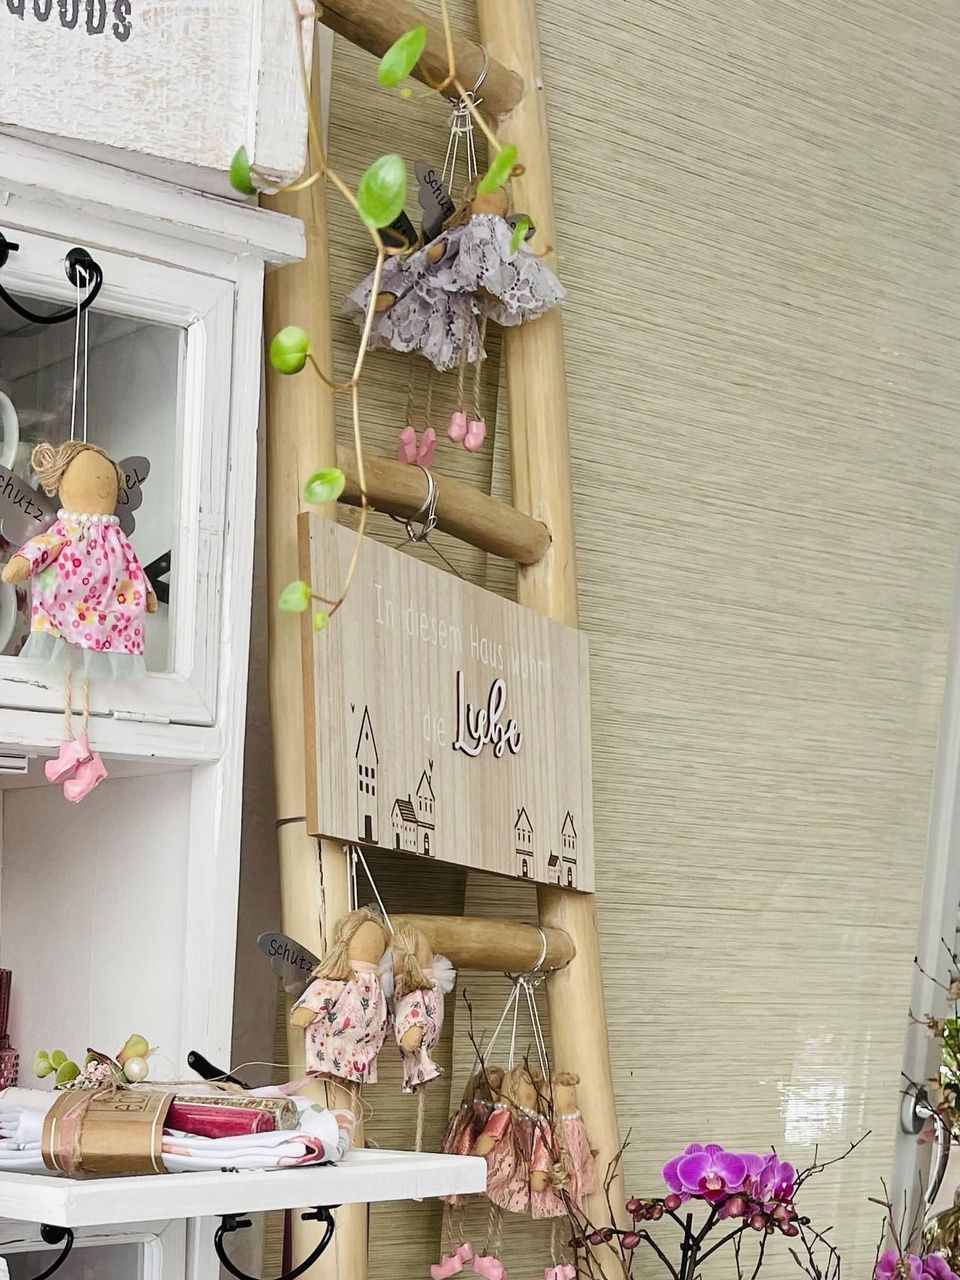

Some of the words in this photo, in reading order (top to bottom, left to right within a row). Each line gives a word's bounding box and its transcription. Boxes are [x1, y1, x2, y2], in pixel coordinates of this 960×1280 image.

[424, 169, 452, 218] Schut
[374, 583, 394, 628] In
[406, 600, 463, 654] diesem
[470, 623, 504, 670] Haus
[452, 670, 523, 759] Liebe
[268, 938, 313, 973] Schutz
